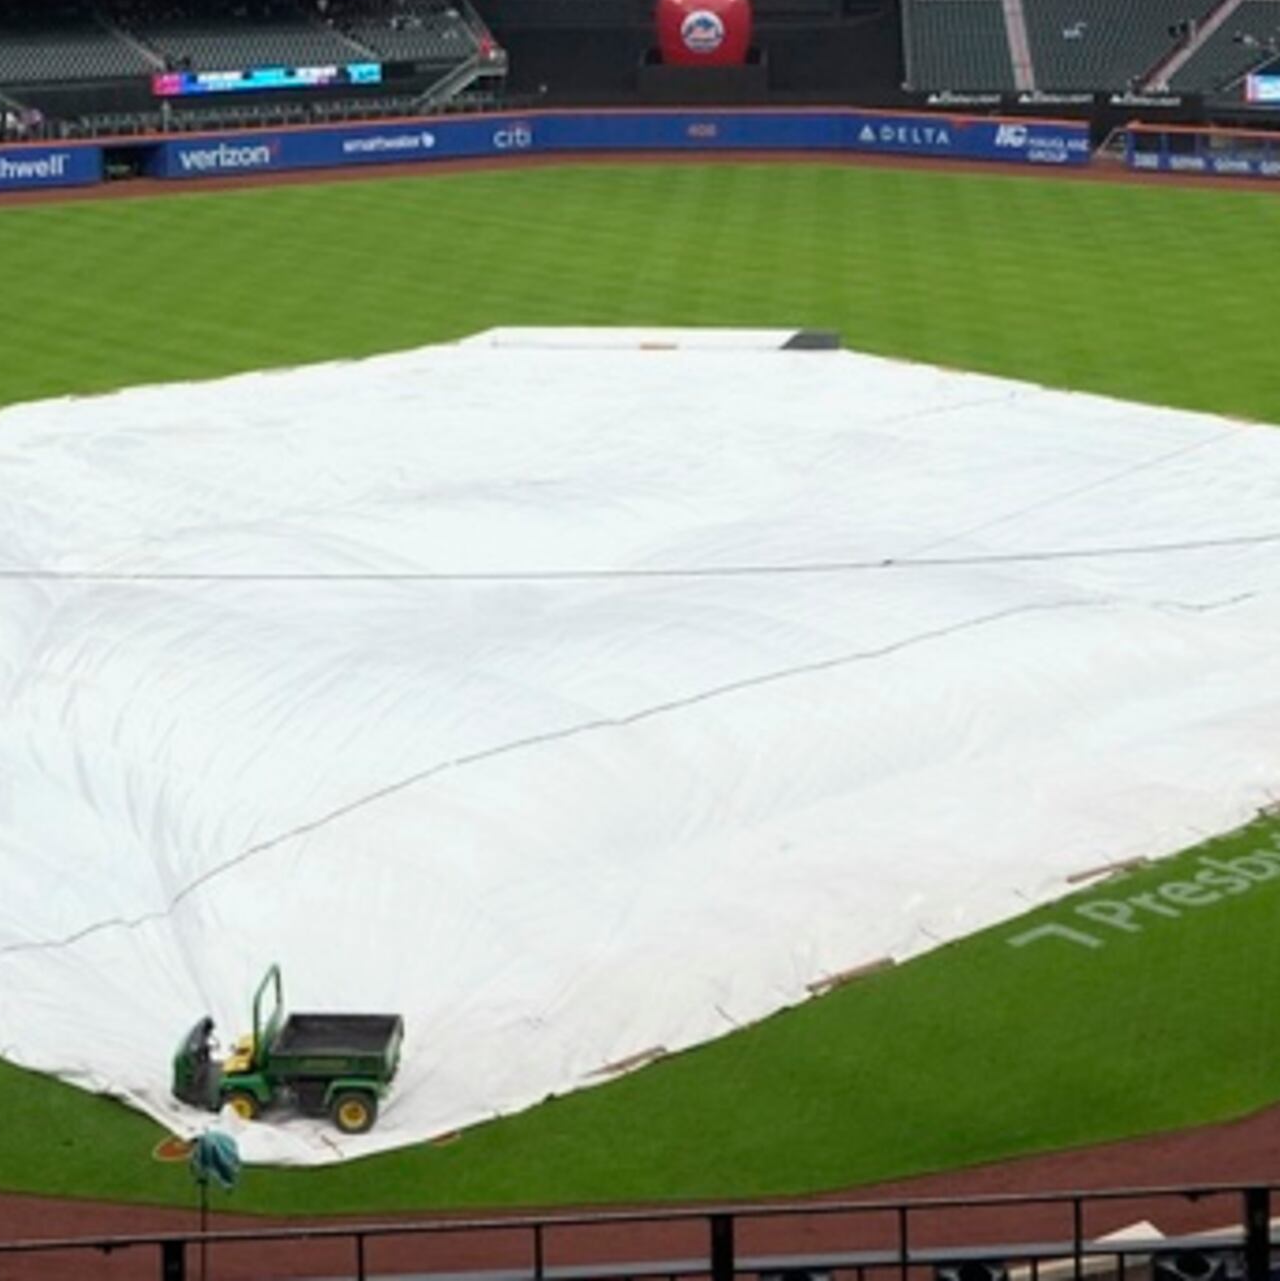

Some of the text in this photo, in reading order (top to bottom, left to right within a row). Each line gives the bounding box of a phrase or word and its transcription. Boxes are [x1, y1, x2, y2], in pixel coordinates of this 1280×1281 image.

[492, 127, 533, 149] citi
[880, 127, 952, 146] DELTA
[179, 141, 271, 170] verizon
